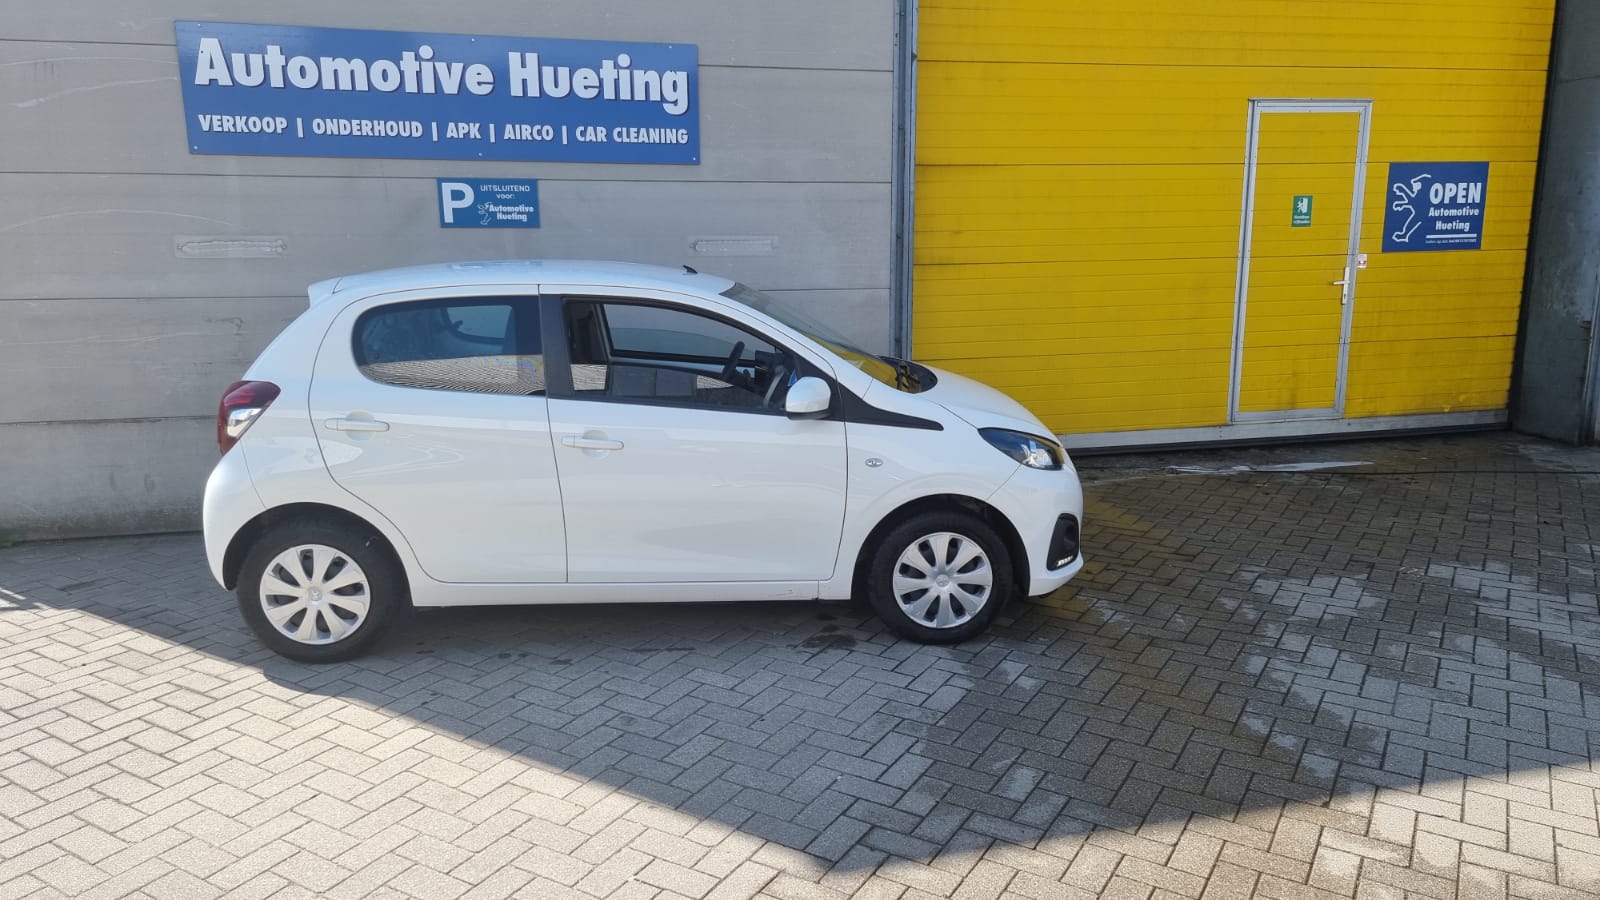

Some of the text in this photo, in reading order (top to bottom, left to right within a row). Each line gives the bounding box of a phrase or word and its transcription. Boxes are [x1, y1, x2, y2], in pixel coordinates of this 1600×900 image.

[195, 38, 689, 115] Automotive Hueting
[198, 114, 689, 144] VERKOOP ONDERHOUD APK AIRCO CAR CLEANING
[480, 184, 530, 192] UITSLUITEND
[1429, 182, 1482, 204] OPEN
[441, 182, 474, 223] P
[489, 204, 534, 213] Automotive
[496, 212, 527, 222] Hueting
[1428, 206, 1480, 217] Automotive
[1435, 220, 1470, 232] Hueting
